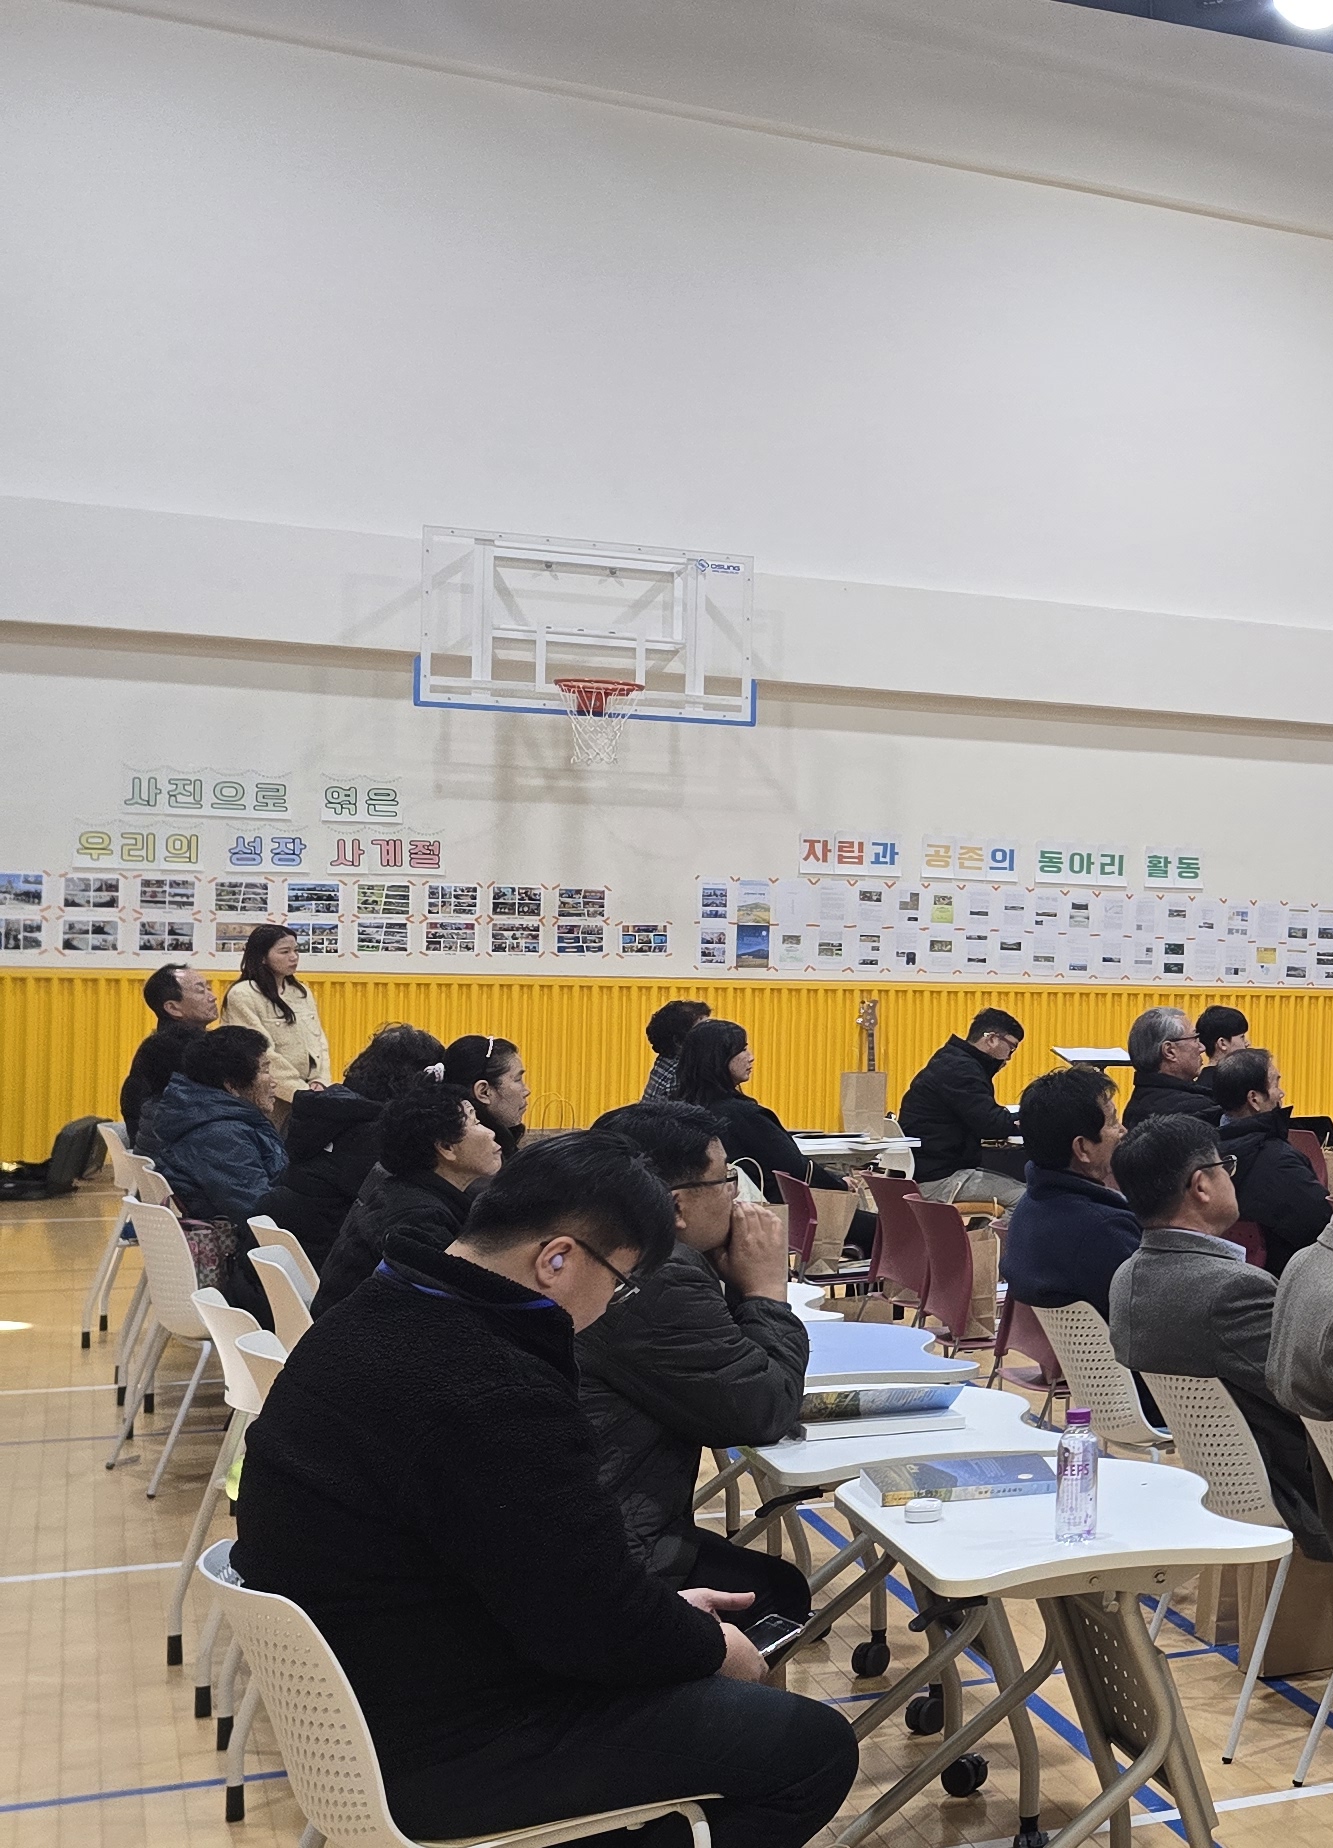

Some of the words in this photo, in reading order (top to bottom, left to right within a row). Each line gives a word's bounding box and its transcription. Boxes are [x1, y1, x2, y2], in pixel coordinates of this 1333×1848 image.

[124, 774, 290, 813] 사진으로
[322, 784, 400, 817] 엮은
[75, 829, 200, 865] 우리의
[227, 832, 306, 868] 성장
[330, 836, 443, 870] 사계절
[802, 837, 900, 866] 자립과
[923, 842, 1016, 872] 공존의
[1037, 848, 1126, 878] 동아리
[1145, 854, 1202, 881] 활동
